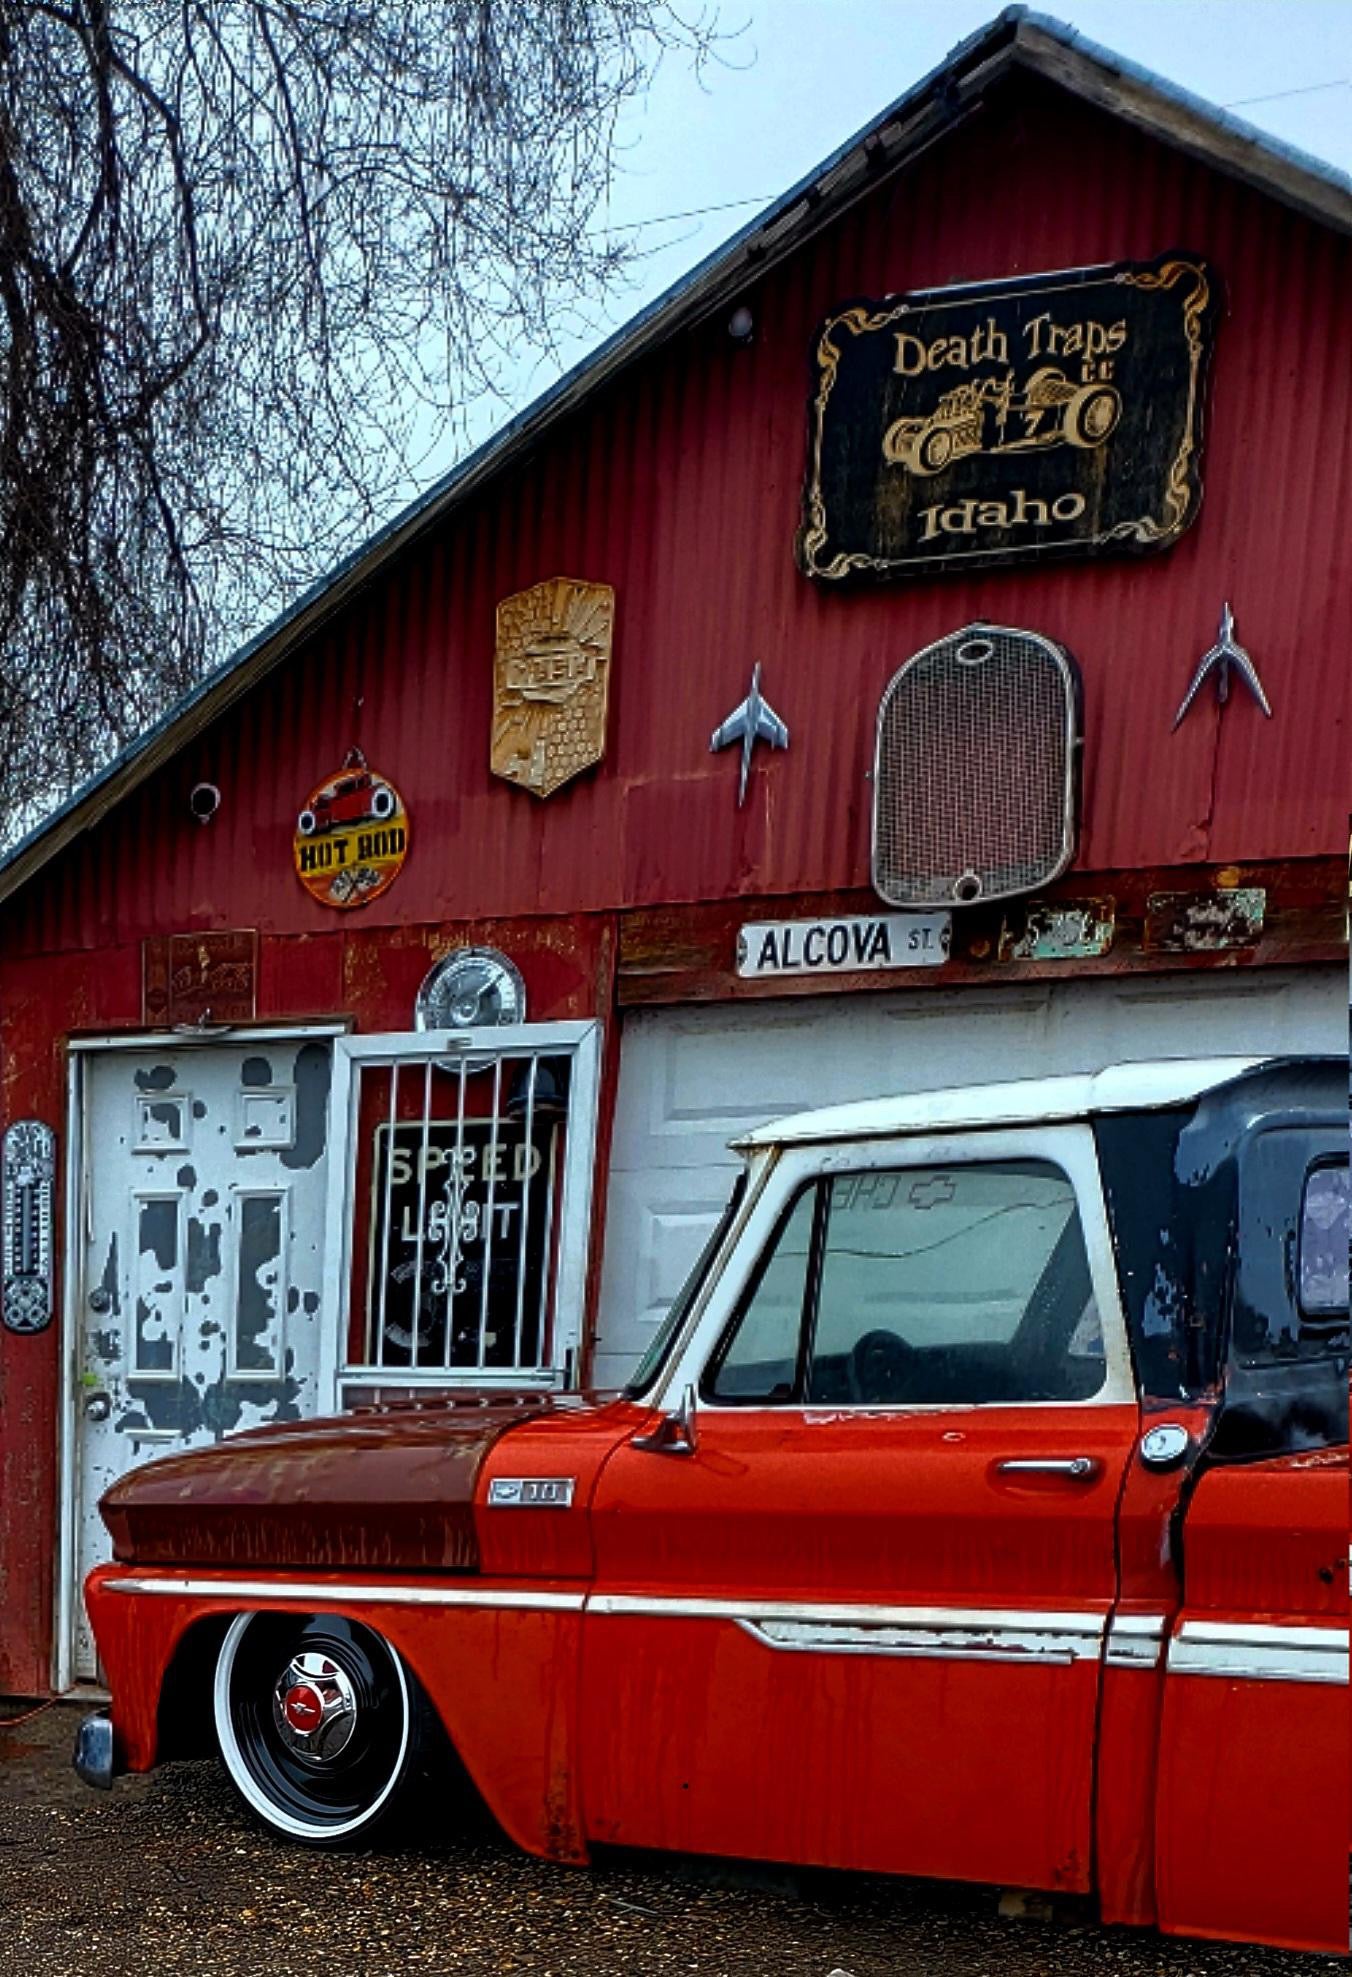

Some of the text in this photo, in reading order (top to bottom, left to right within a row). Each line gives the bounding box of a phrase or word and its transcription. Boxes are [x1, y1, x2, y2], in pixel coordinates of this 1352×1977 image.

[893, 312, 1126, 377] Death Traps
[917, 489, 1086, 543] Idaho
[300, 828, 405, 872] HOT ROD
[757, 922, 892, 969] ALCOVA
[400, 1202, 520, 1242] LIT
